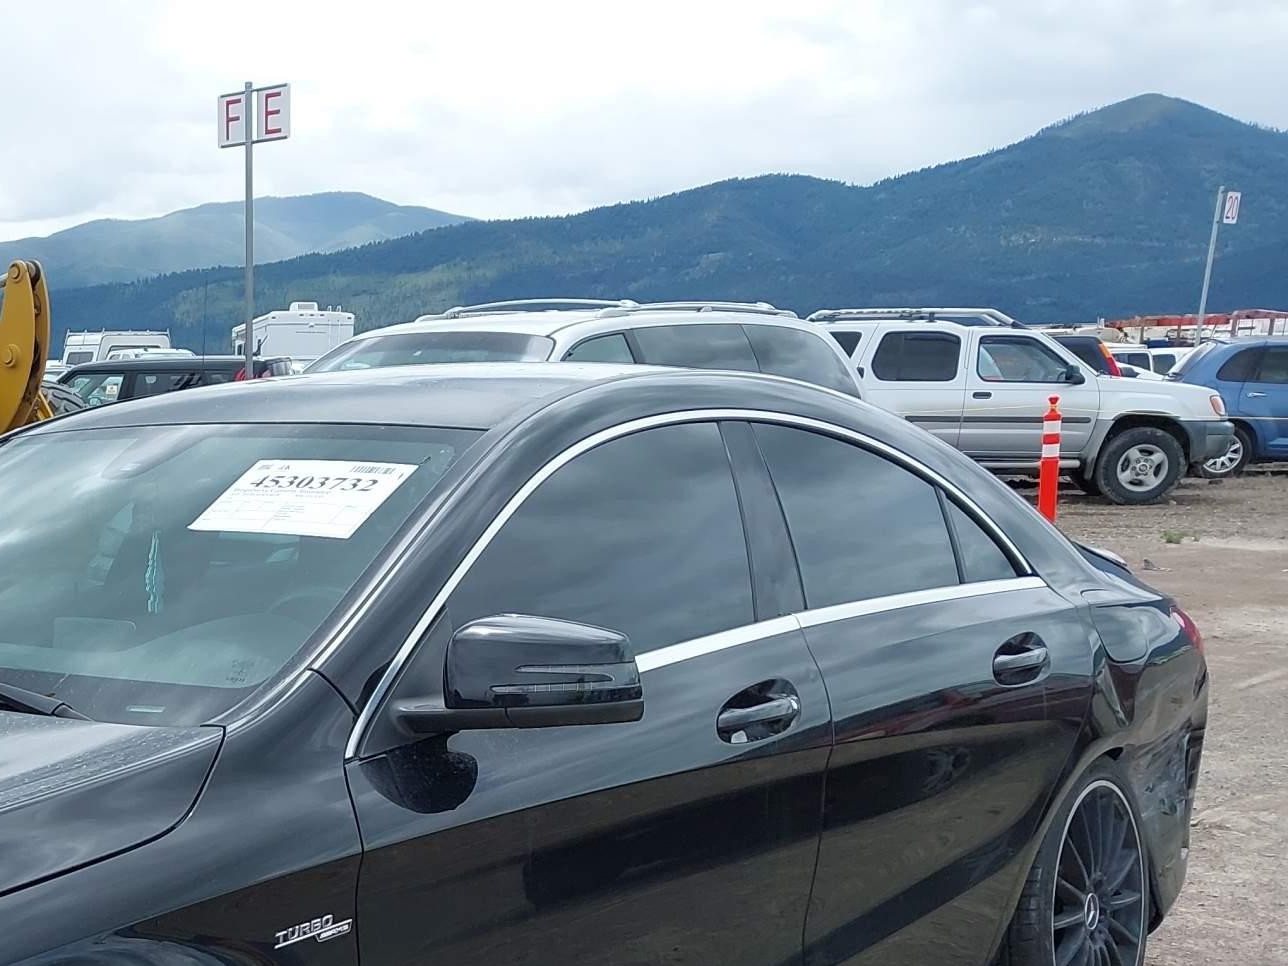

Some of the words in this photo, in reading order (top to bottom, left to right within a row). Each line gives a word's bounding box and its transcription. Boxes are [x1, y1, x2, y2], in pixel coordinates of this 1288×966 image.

[225, 97, 242, 141] F
[264, 91, 282, 135] E
[1225, 195, 1239, 221] 20
[250, 474, 380, 492] 45303732
[274, 913, 334, 944] TURBO
